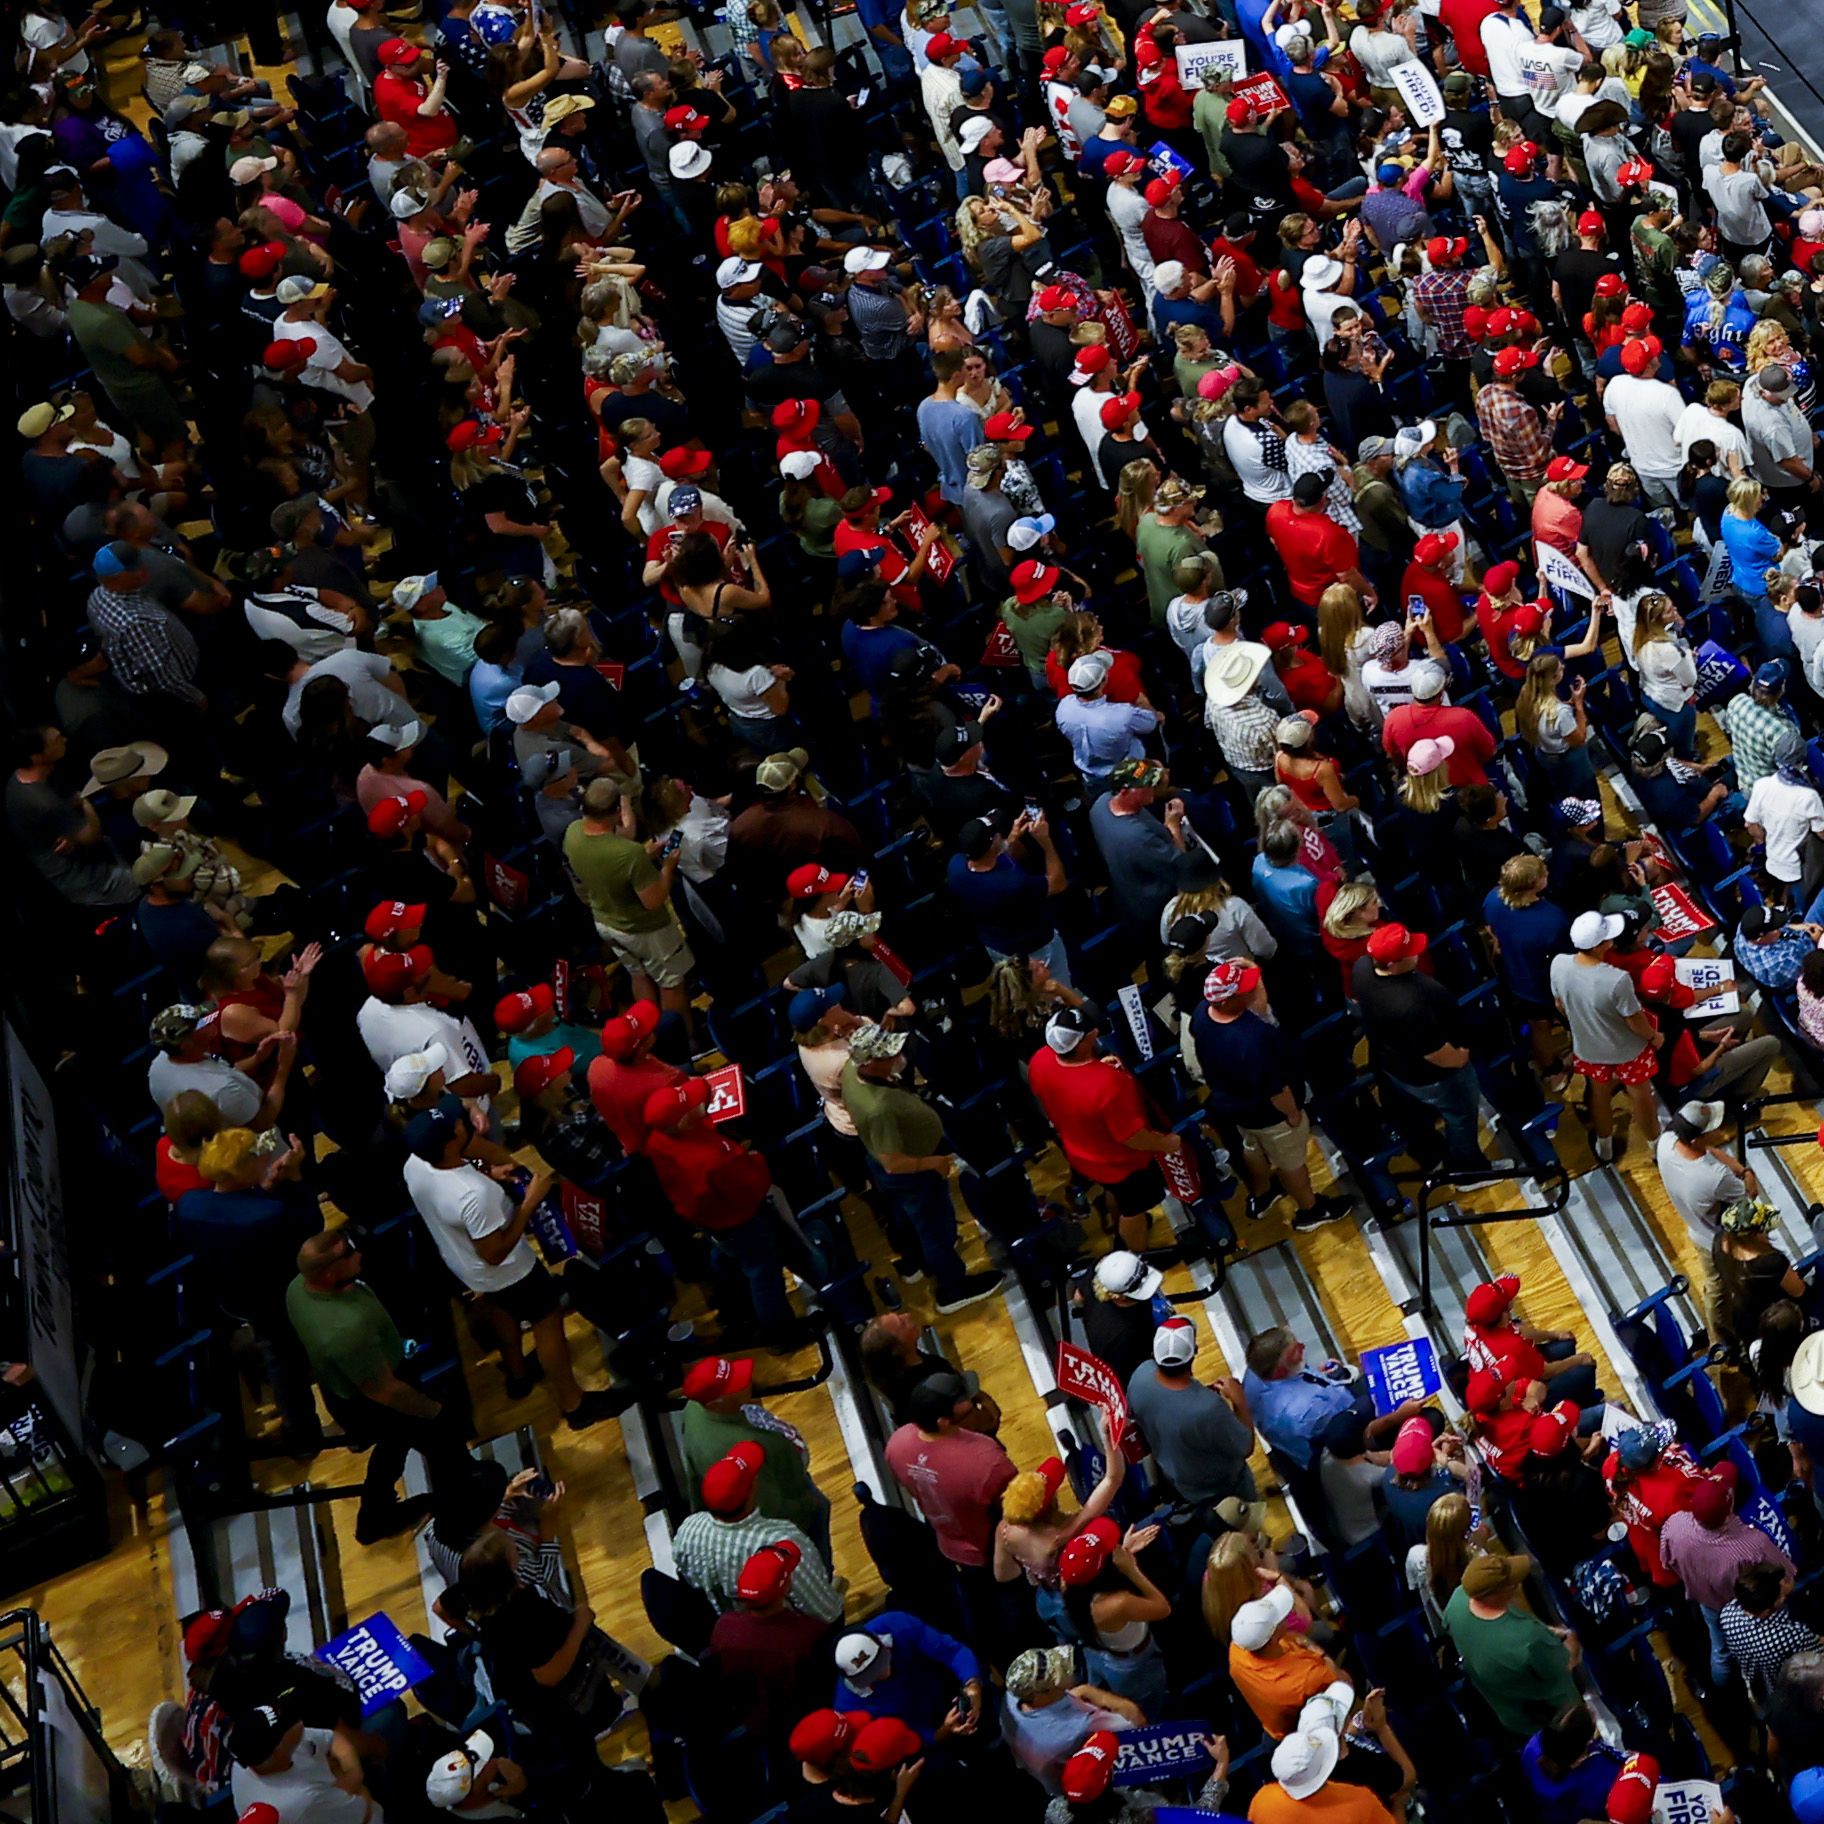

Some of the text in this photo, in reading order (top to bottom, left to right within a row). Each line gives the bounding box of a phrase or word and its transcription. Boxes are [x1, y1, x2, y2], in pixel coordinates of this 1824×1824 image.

[1187, 52, 1234, 67] YOU'RE
[1520, 58, 1551, 72] NASA
[1399, 69, 1434, 119] FIRED!
[1410, 66, 1438, 109] YOU'RE
[1653, 890, 1698, 933] TRUMP
[1383, 1352, 1405, 1399] VANCE
[1403, 1343, 1425, 1400] TRUMP
[337, 1641, 381, 1698] VANCE
[347, 1628, 407, 1696] TRUMP
